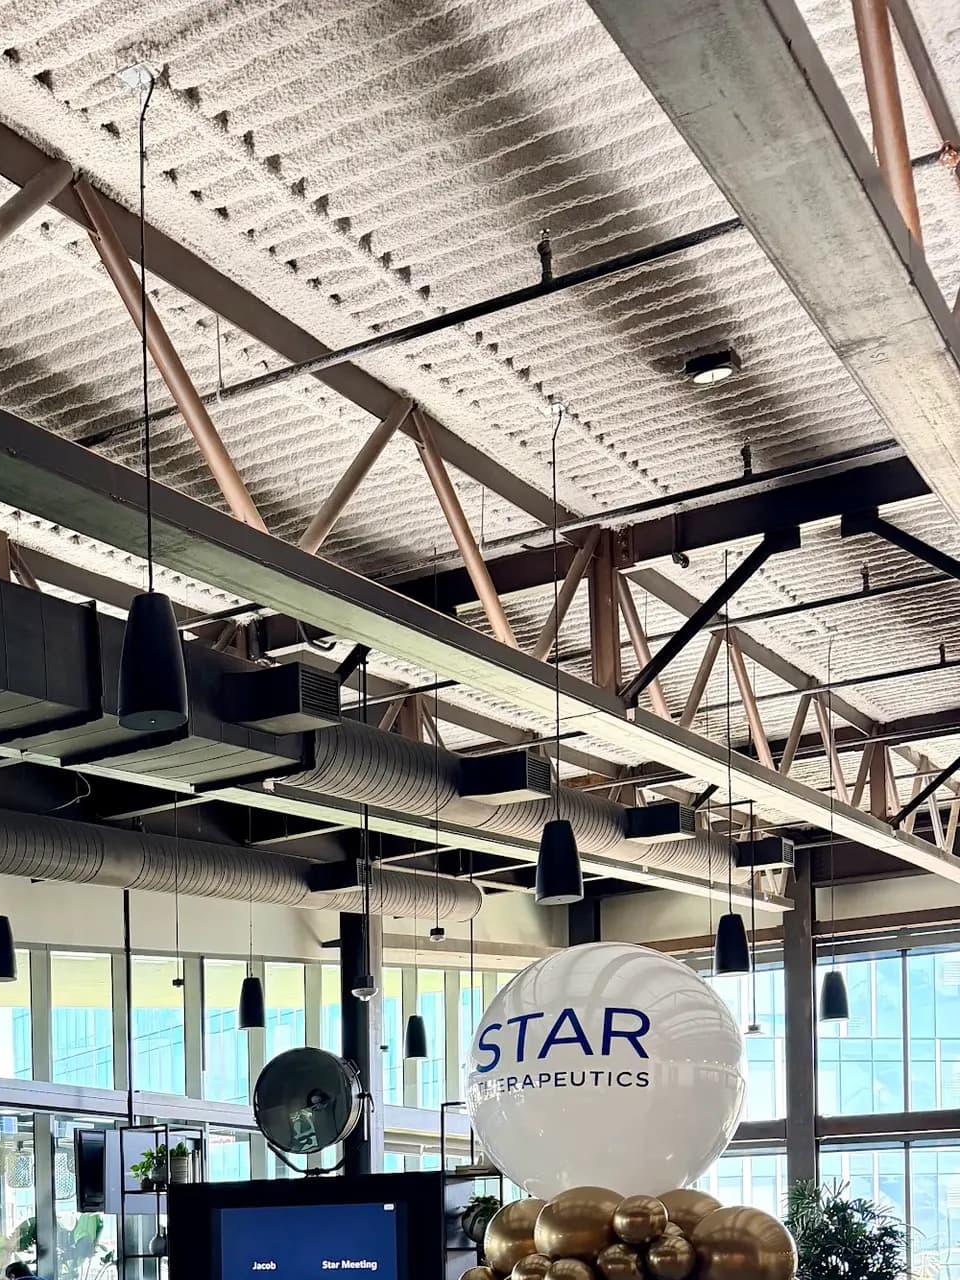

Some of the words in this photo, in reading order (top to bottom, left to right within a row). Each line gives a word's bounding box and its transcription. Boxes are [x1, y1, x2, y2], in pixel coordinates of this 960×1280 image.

[475, 1007, 651, 1073] STAR
[478, 1071, 650, 1096] THERAPEUTICS
[252, 1261, 277, 1271] Jacob
[322, 1260, 340, 1270] Star
[341, 1259, 378, 1271] Meeting
